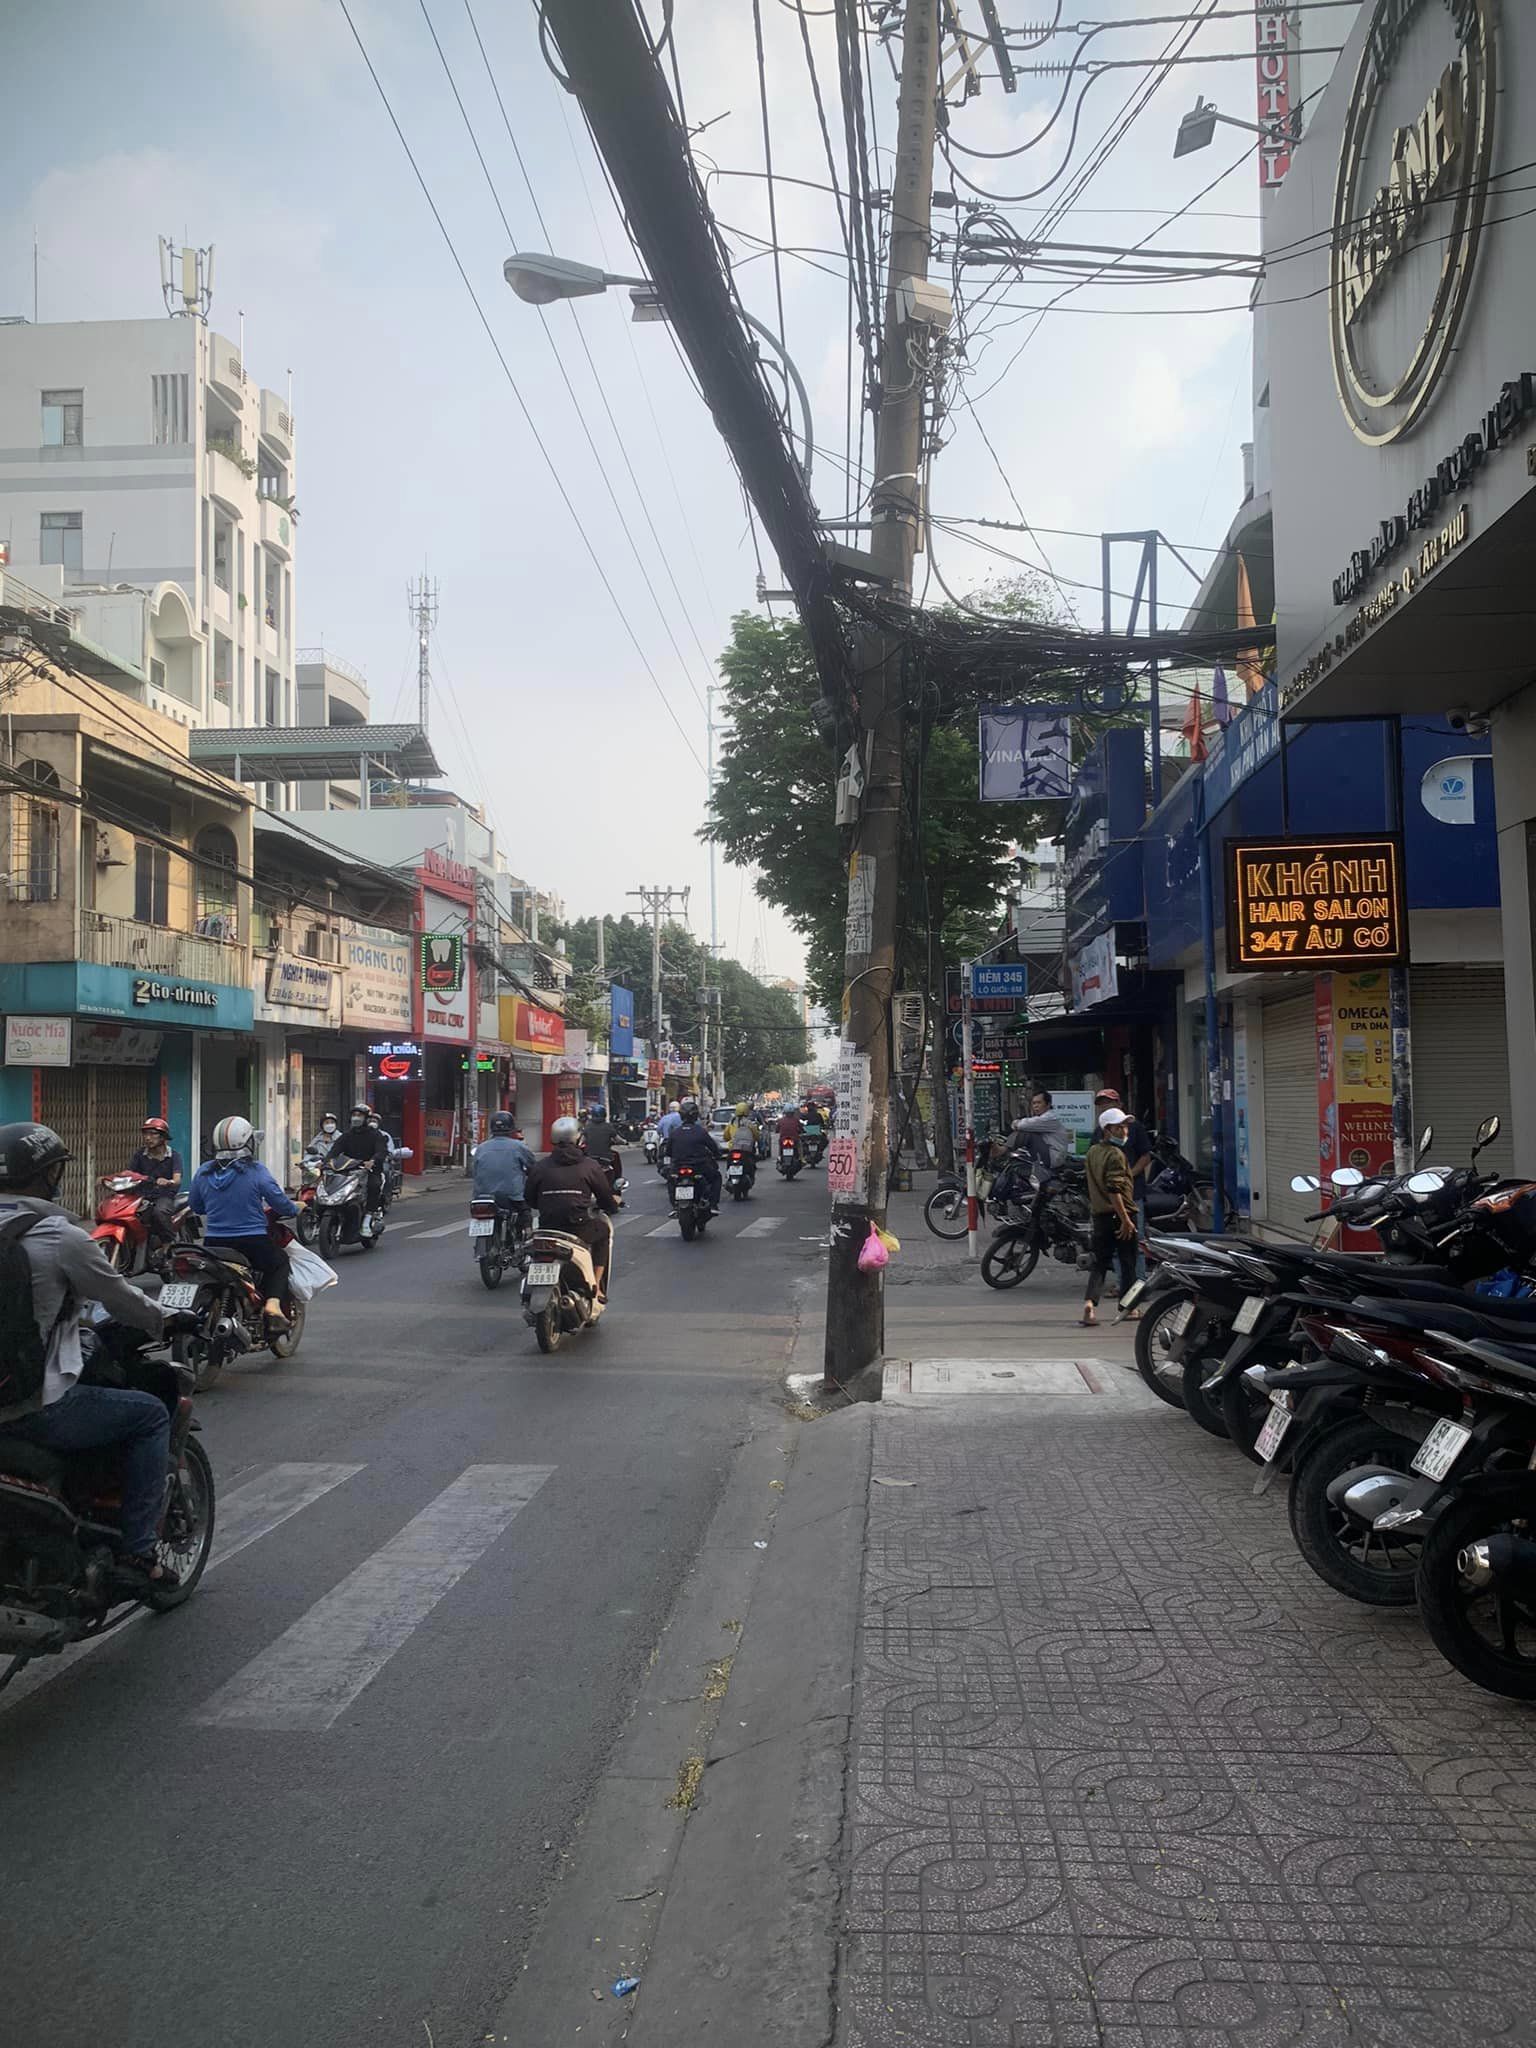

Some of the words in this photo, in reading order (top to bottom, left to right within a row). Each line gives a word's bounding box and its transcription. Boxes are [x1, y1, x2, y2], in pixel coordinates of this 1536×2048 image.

[1258, 14, 1287, 184] HOTEL
[1416, 537, 1440, 578] TÂN
[1440, 503, 1468, 557] PHÚ
[1246, 854, 1388, 897] KHÁNH
[1249, 900, 1305, 923] HAIR
[1313, 897, 1389, 921] SALON
[1249, 930, 1299, 952] 347
[1305, 924, 1343, 949] ÂU
[1353, 922, 1390, 947] CƠ
[1003, 971, 1023, 983] 345
[1338, 1006, 1389, 1020] OMEGA
[1350, 1022, 1367, 1031] EPA
[1370, 1021, 1389, 1030] DHA
[828, 1153, 852, 1175] 550
